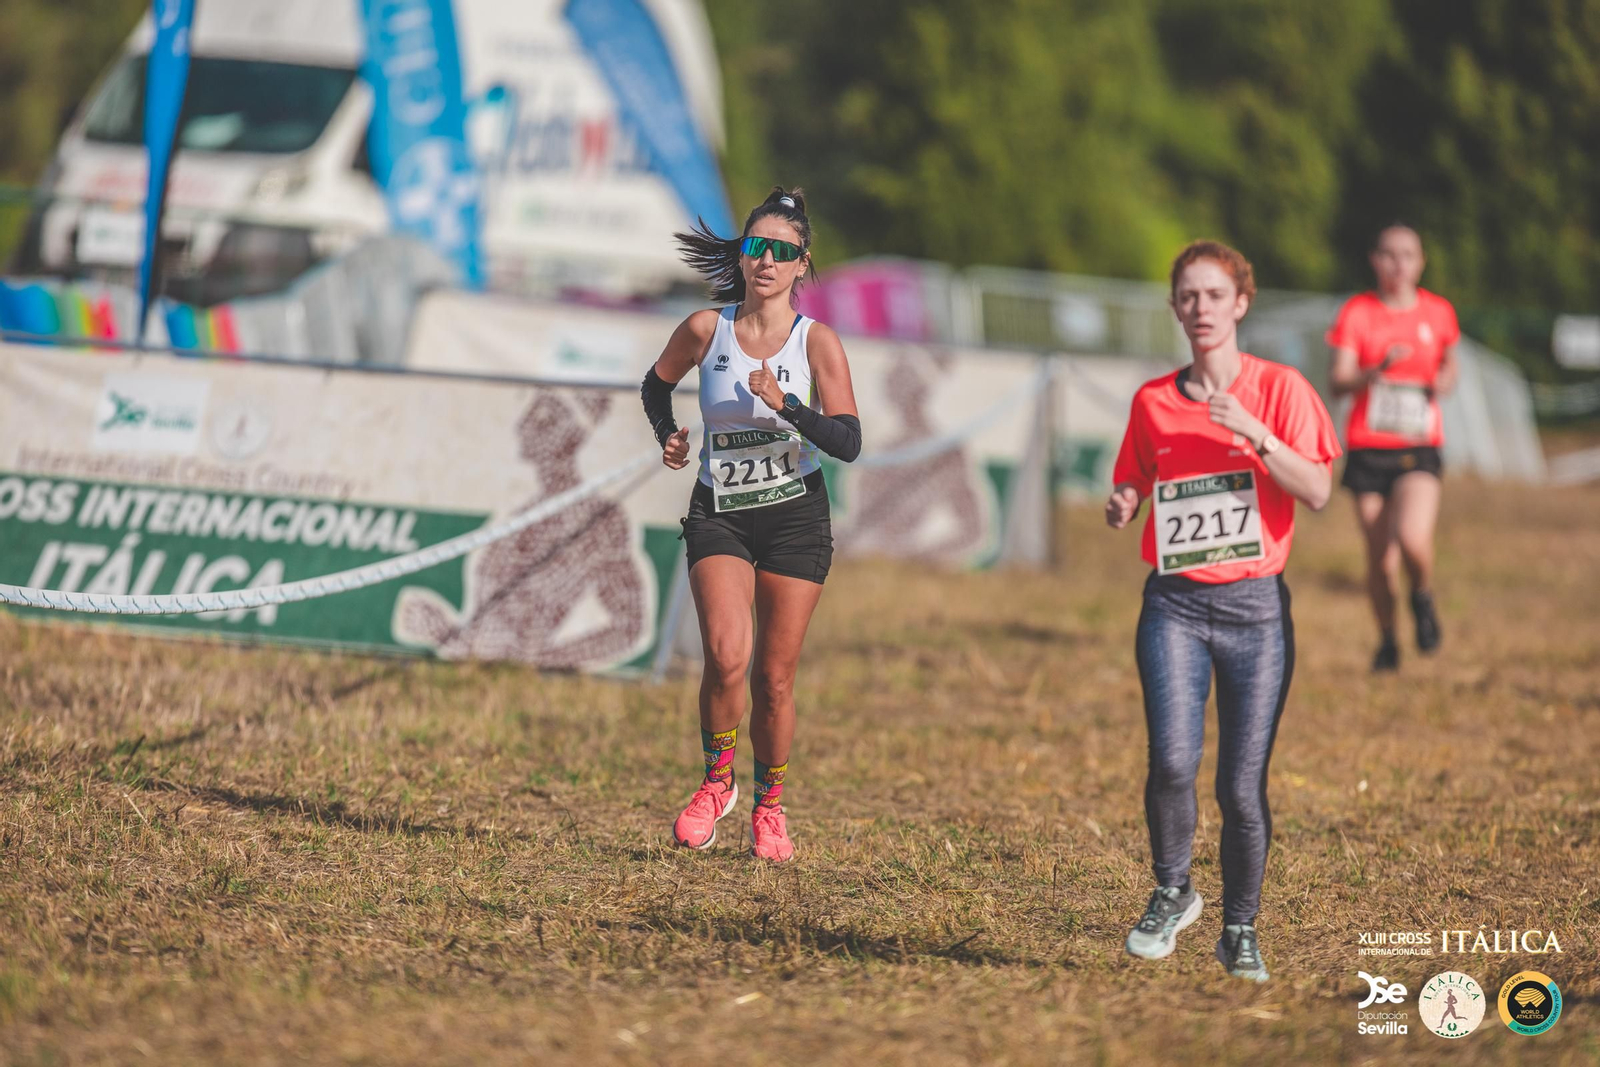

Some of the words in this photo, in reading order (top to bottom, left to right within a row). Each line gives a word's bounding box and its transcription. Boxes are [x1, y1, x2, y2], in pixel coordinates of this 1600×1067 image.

[719, 451, 795, 488] 2211
[77, 484, 420, 554] INTERNACIONAL
[1166, 505, 1250, 546] 2217
